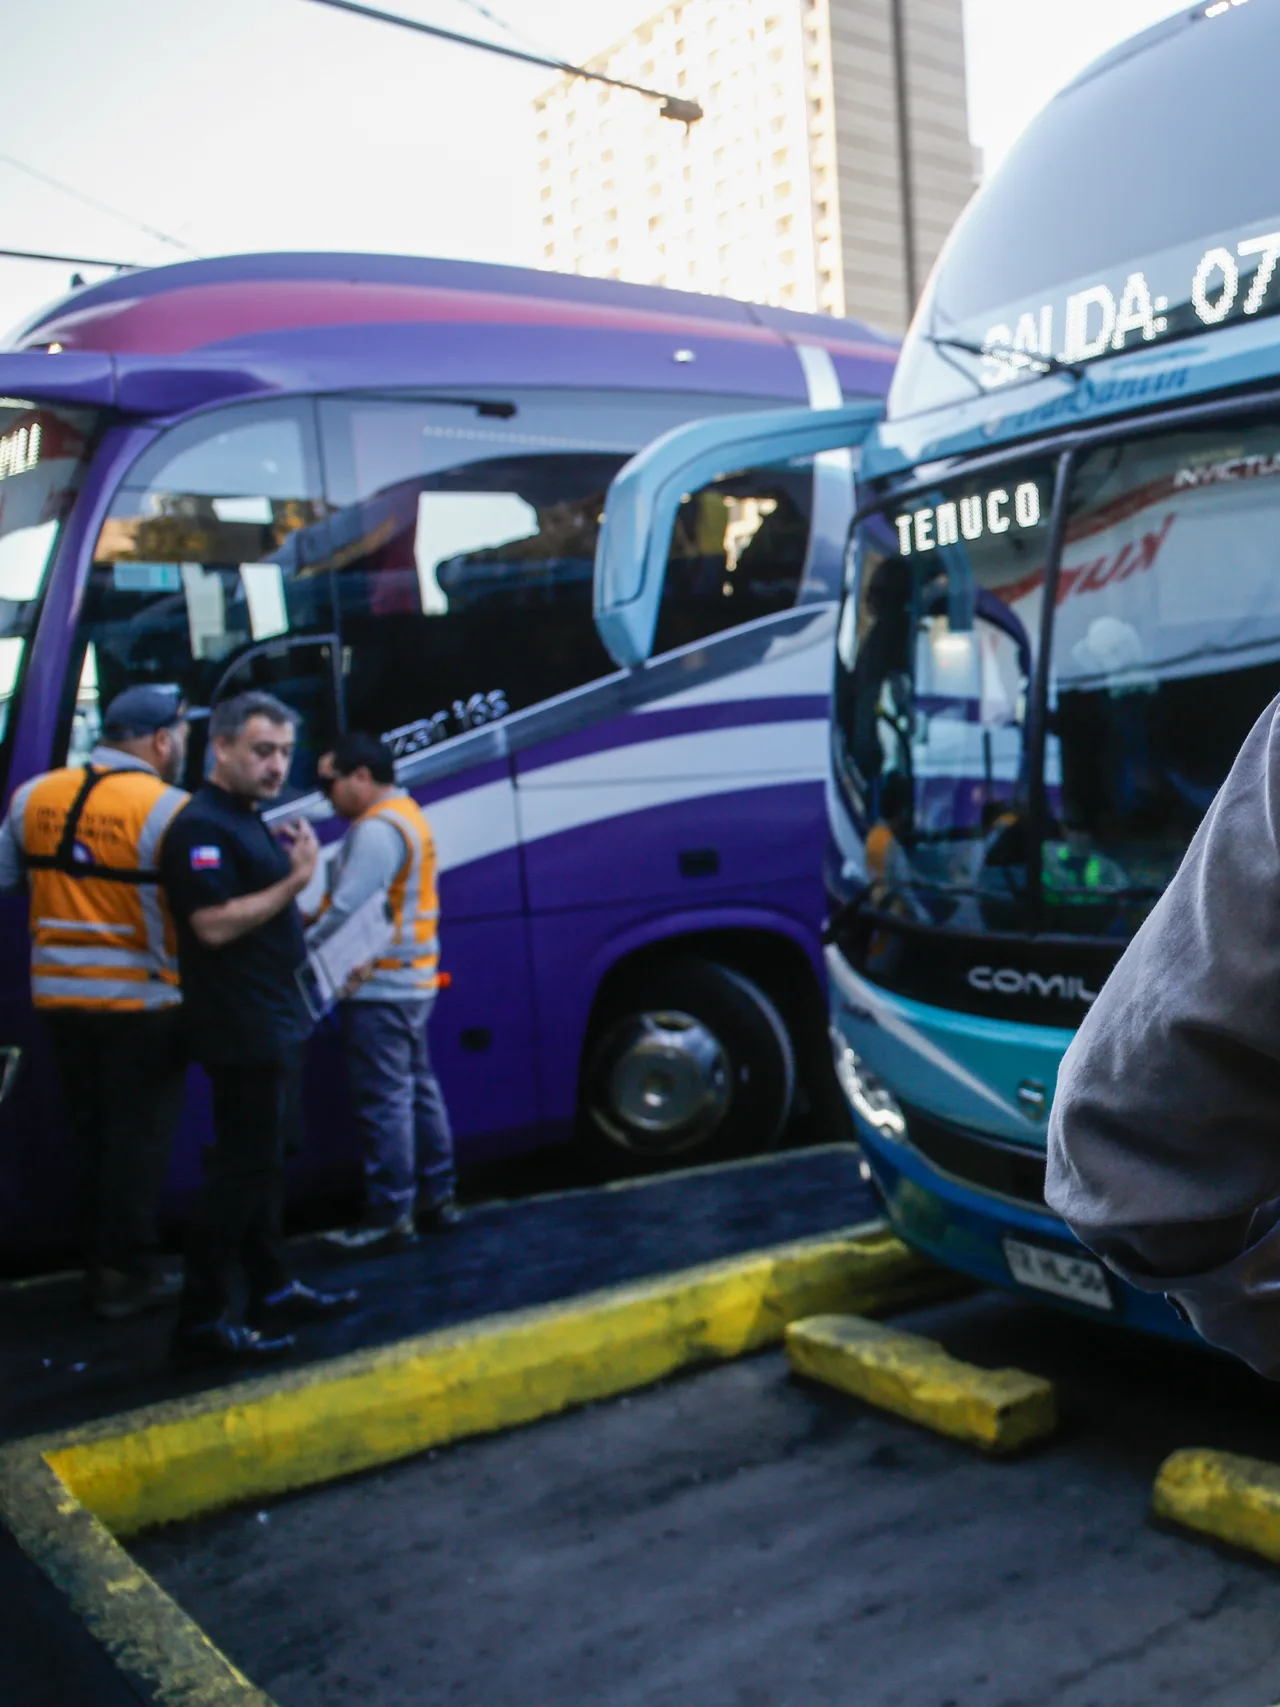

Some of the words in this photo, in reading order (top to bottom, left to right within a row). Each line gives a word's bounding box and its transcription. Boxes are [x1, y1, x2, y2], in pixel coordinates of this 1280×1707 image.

[980, 271, 1168, 388] SALIDA:
[894, 481, 1041, 557] TEMUCO
[967, 965, 1100, 1002] COMIL
